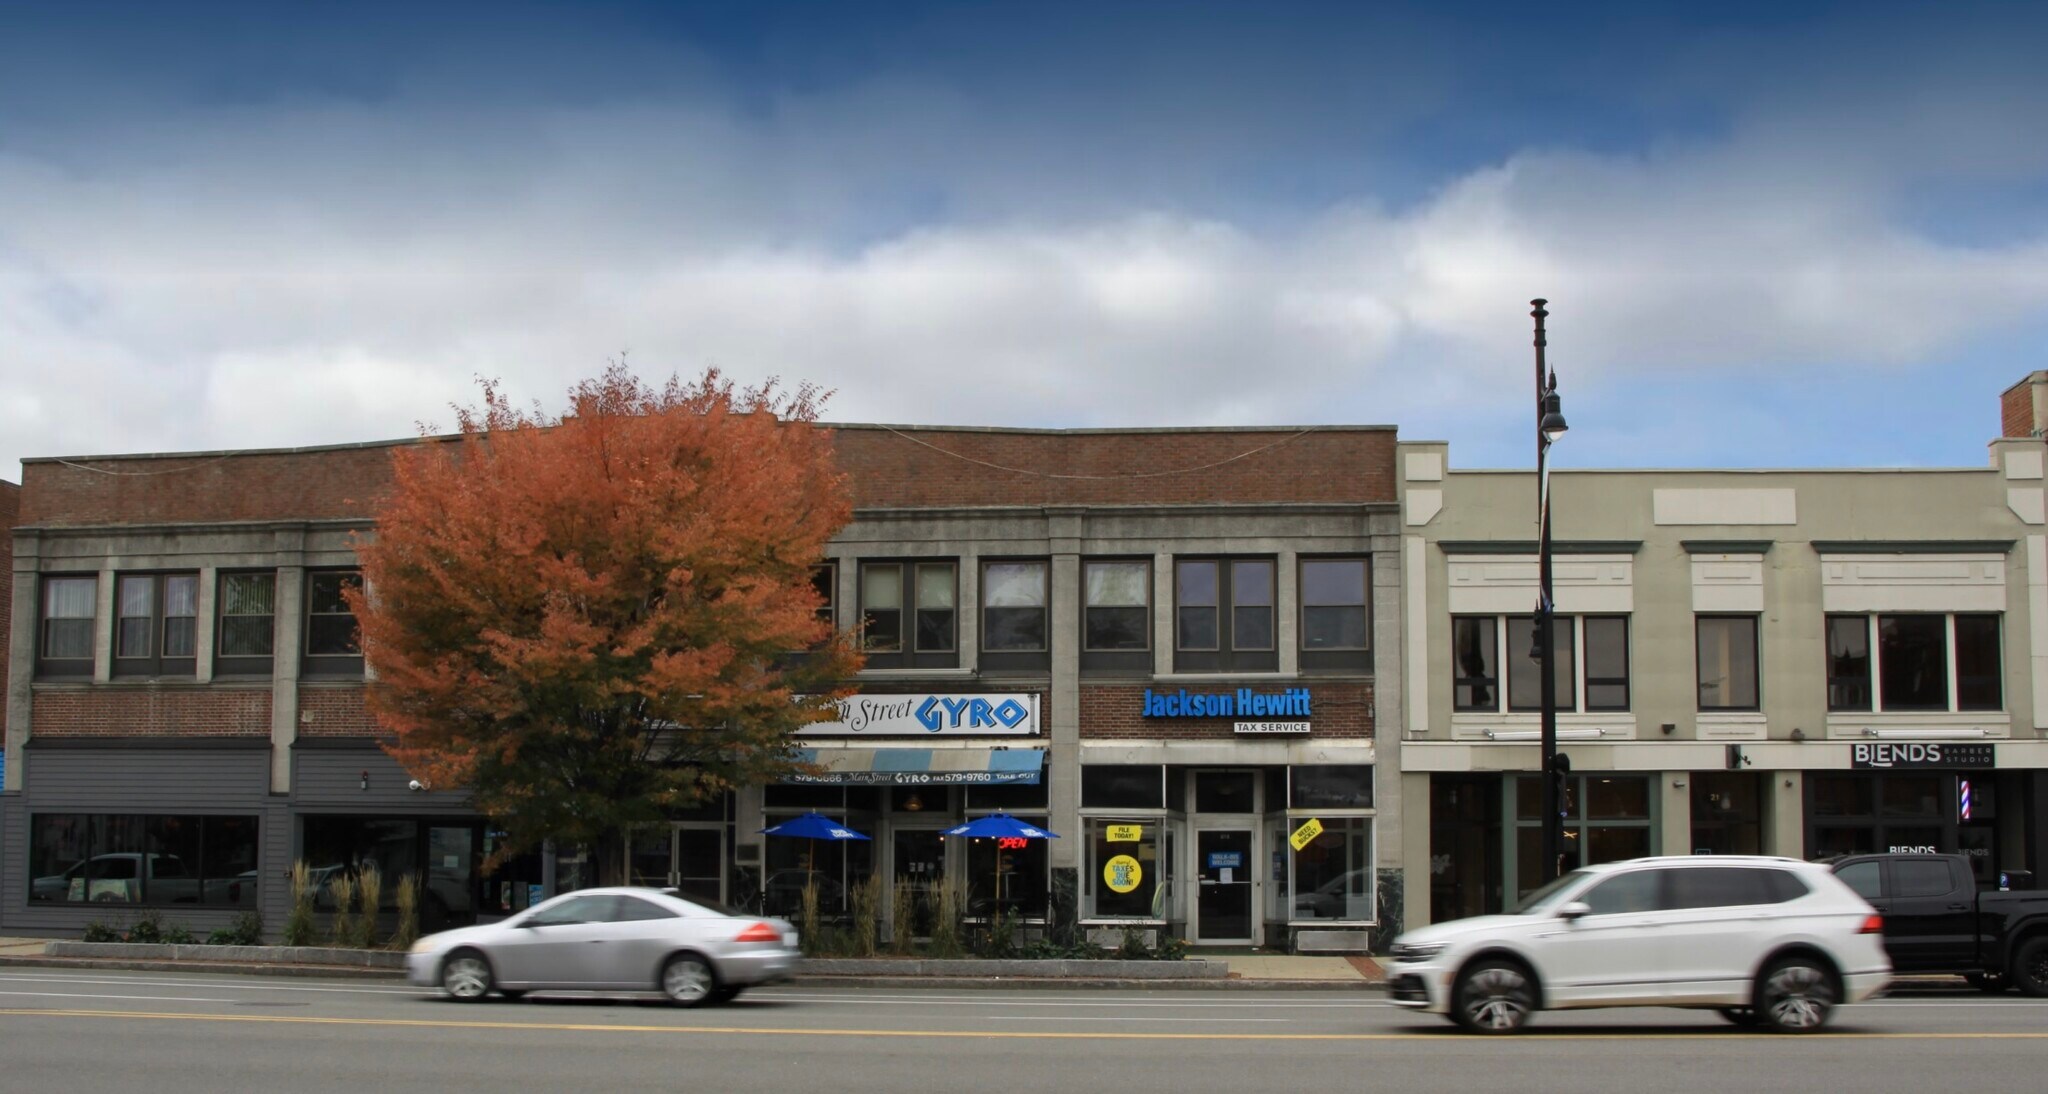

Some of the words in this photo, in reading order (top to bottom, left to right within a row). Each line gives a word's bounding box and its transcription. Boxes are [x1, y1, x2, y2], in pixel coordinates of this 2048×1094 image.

[1142, 688, 1233, 717] Jackson
[1237, 688, 1311, 716] Hewitt
[851, 699, 913, 731] Street
[914, 695, 1028, 732] GYRO
[1237, 723, 1257, 732] TAX
[1261, 723, 1308, 732] SERVICE
[894, 772, 930, 783] GYRO
[999, 837, 1028, 849] OPEN
